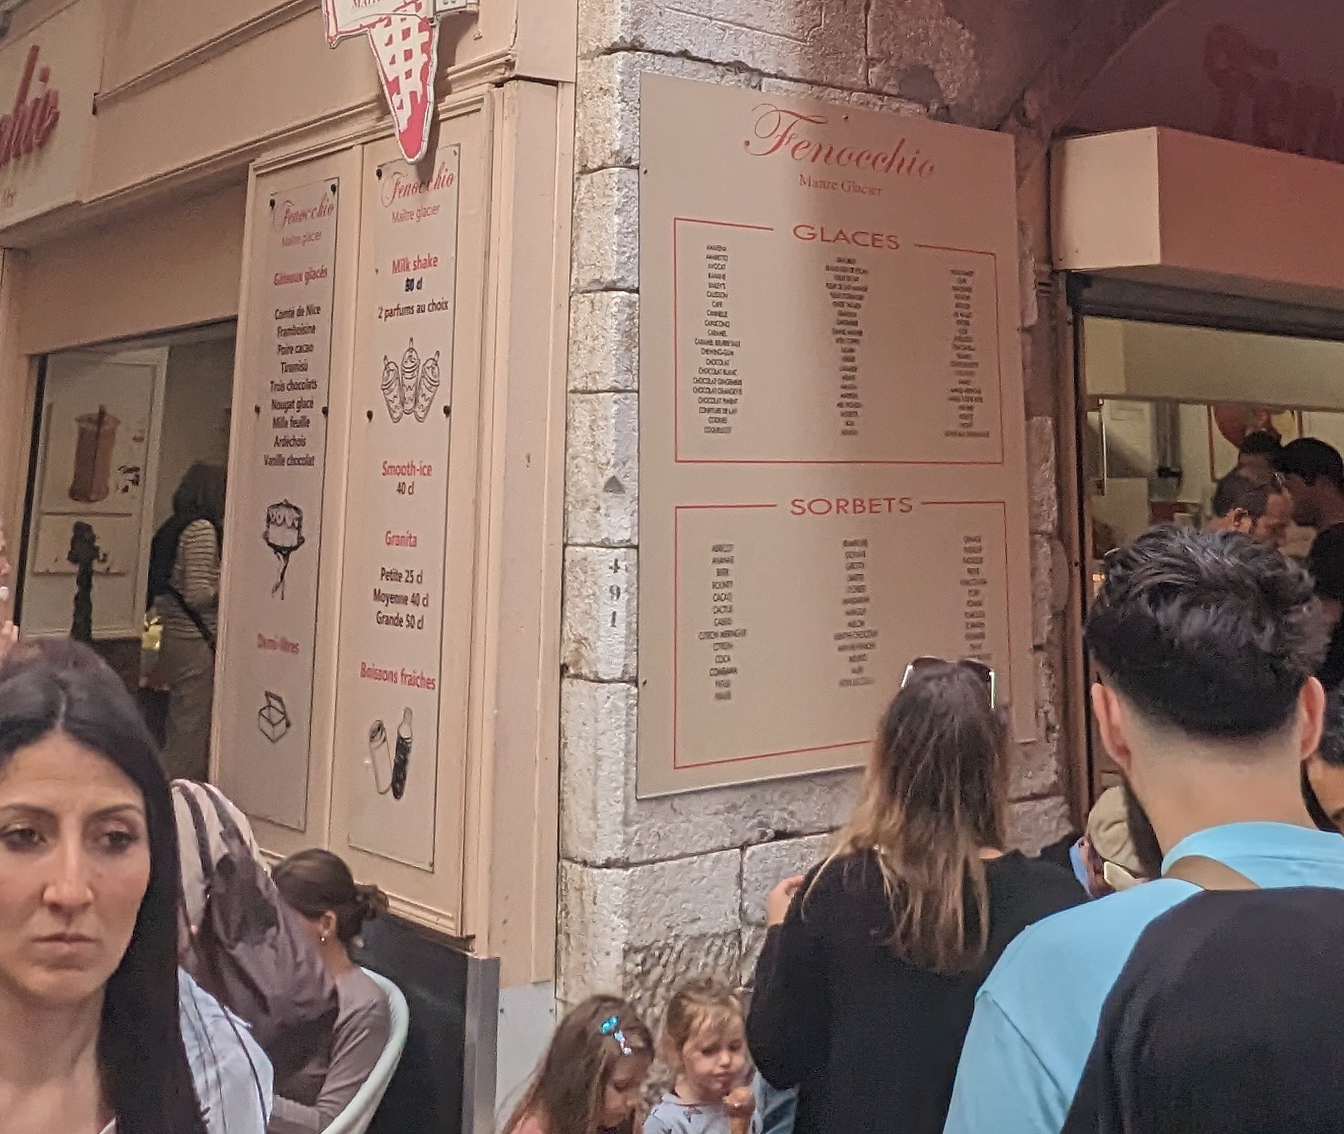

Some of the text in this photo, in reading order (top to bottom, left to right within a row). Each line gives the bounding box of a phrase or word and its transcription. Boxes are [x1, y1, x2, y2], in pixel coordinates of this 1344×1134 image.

[743, 102, 936, 180] Fenocchio
[380, 162, 455, 208] Fenocchio
[841, 179, 884, 198] Glacier
[415, 203, 441, 223] glacier
[792, 224, 900, 251] GLACES
[391, 252, 439, 276] Milk shake
[304, 264, 328, 286] glacés
[416, 277, 423, 291] cl
[377, 297, 449, 323] 2 parfums au choix
[277, 343, 315, 356] Poire cacao
[270, 379, 286, 393] Trois
[270, 396, 315, 414] Nougat glacé
[272, 415, 311, 429] Mille feuille
[263, 453, 316, 467] Vanille chocolat
[381, 460, 433, 478] Smooth-ice
[396, 481, 415, 496] 40 cl
[790, 496, 914, 516] SORBETS
[384, 530, 418, 548] Granita
[380, 566, 424, 585] Petite 25 cl
[410, 592, 421, 607] 40
[422, 592, 430, 608] cl
[375, 610, 425, 631] Grande 50 cl
[359, 661, 399, 684] Boissons
